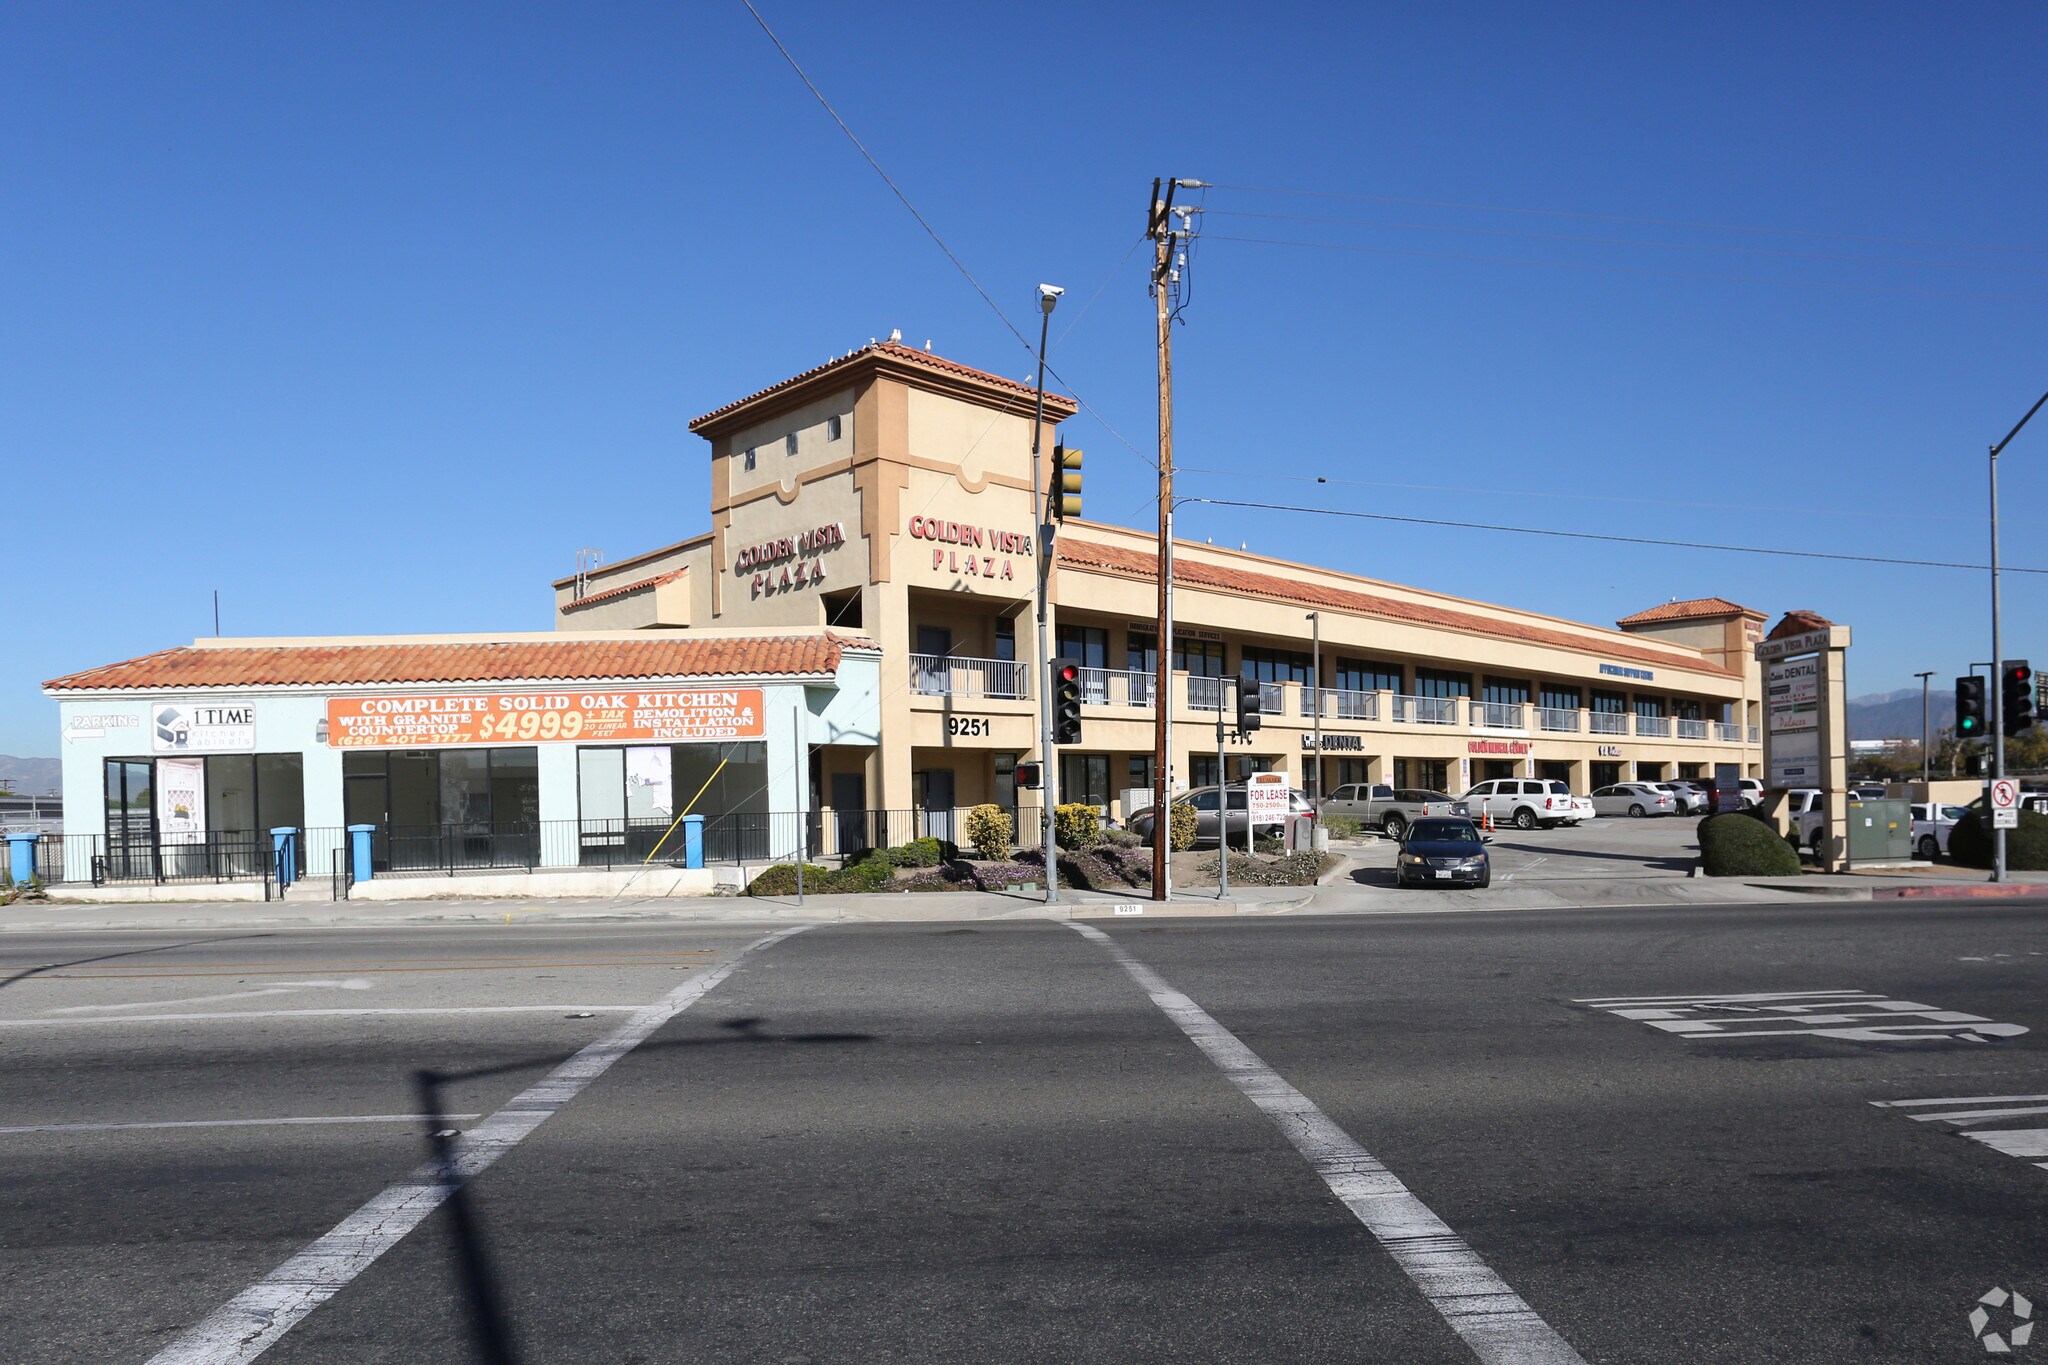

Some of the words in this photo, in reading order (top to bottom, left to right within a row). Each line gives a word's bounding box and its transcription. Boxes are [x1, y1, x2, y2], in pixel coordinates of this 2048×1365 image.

[909, 515, 983, 548] GOLDEN
[988, 529, 1034, 556] VISTA
[738, 535, 798, 568] GOLDEN
[801, 522, 846, 550] VISTA
[932, 549, 1014, 581] PLAZA
[754, 558, 826, 593] PLAZA
[1804, 634, 1828, 647] PLAZA
[1785, 665, 1817, 679] DENTAL
[361, 697, 488, 714] COMPLETE
[499, 695, 570, 711] SOLID
[580, 695, 629, 709] OAK
[637, 692, 738, 708] KITCHEN
[194, 711, 200, 724] 1
[207, 709, 253, 724] TIME
[338, 716, 387, 726] WITH
[393, 713, 472, 725] GRANITE
[601, 710, 626, 719] TAX
[633, 707, 735, 719] DEMOLITION
[741, 707, 754, 717] &
[72, 715, 139, 728] PARKING
[479, 710, 583, 739] $4999
[583, 723, 596, 731] 20
[598, 722, 628, 730] LINEAR
[633, 716, 754, 729] INSTALLATION
[948, 717, 989, 736] 9251
[349, 724, 459, 736] COUNTERTOP
[653, 727, 738, 738] INCLUDED
[189, 738, 250, 746] Cabinets
[338, 736, 379, 746] (626)
[386, 733, 472, 744] 401-3777
[1323, 735, 1363, 751] DENTAL
[1250, 789, 1265, 801] FOR
[1266, 789, 1287, 800] LEASE
[1119, 905, 1137, 913] 9251
